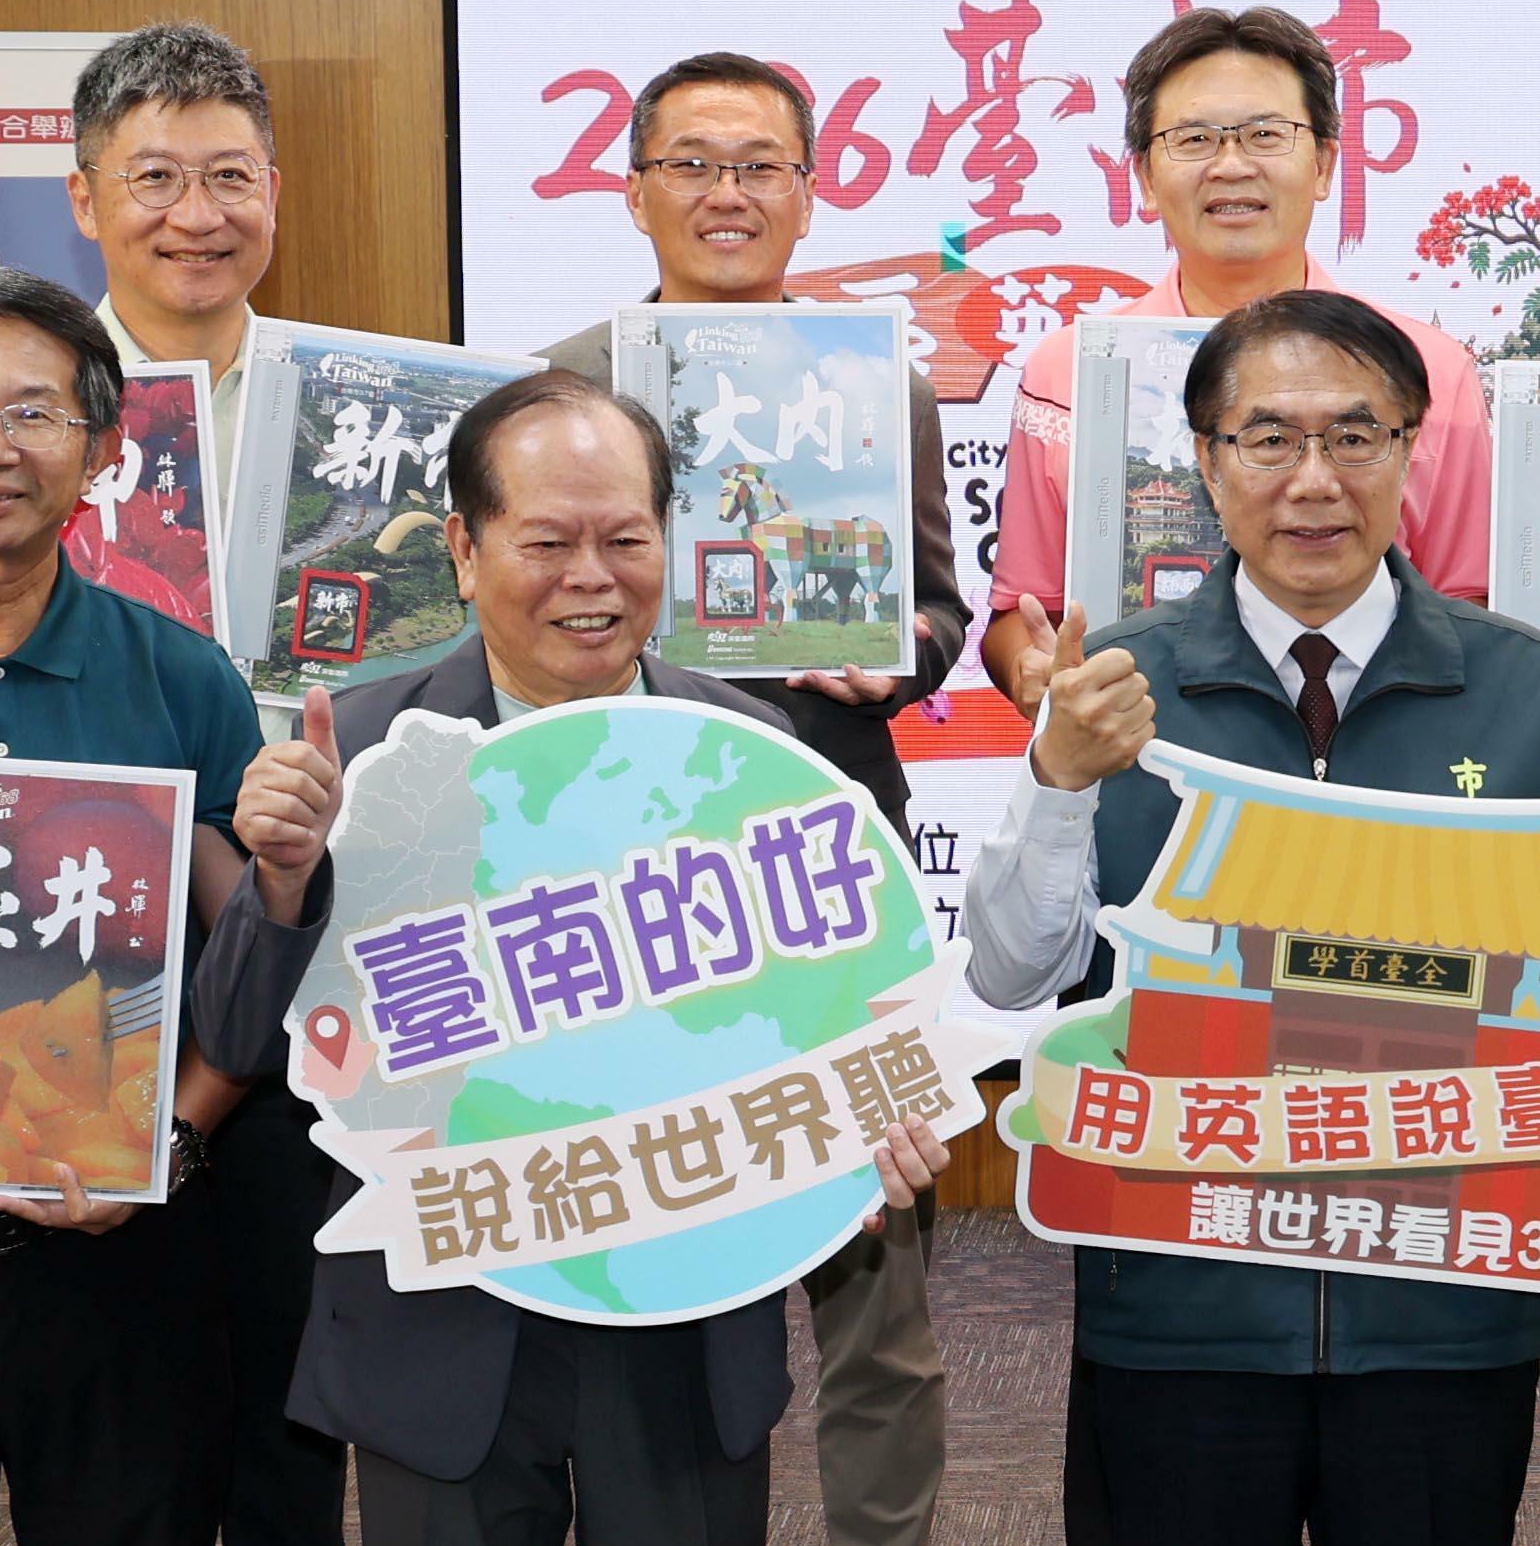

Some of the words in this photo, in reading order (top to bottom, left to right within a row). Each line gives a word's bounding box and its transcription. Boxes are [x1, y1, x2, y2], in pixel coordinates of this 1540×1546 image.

[332, 364, 393, 387] Taiwan
[696, 338, 757, 355] Taiwan
[354, 801, 875, 1073] 臺南的好
[410, 1026, 955, 1266] 說給世界聽
